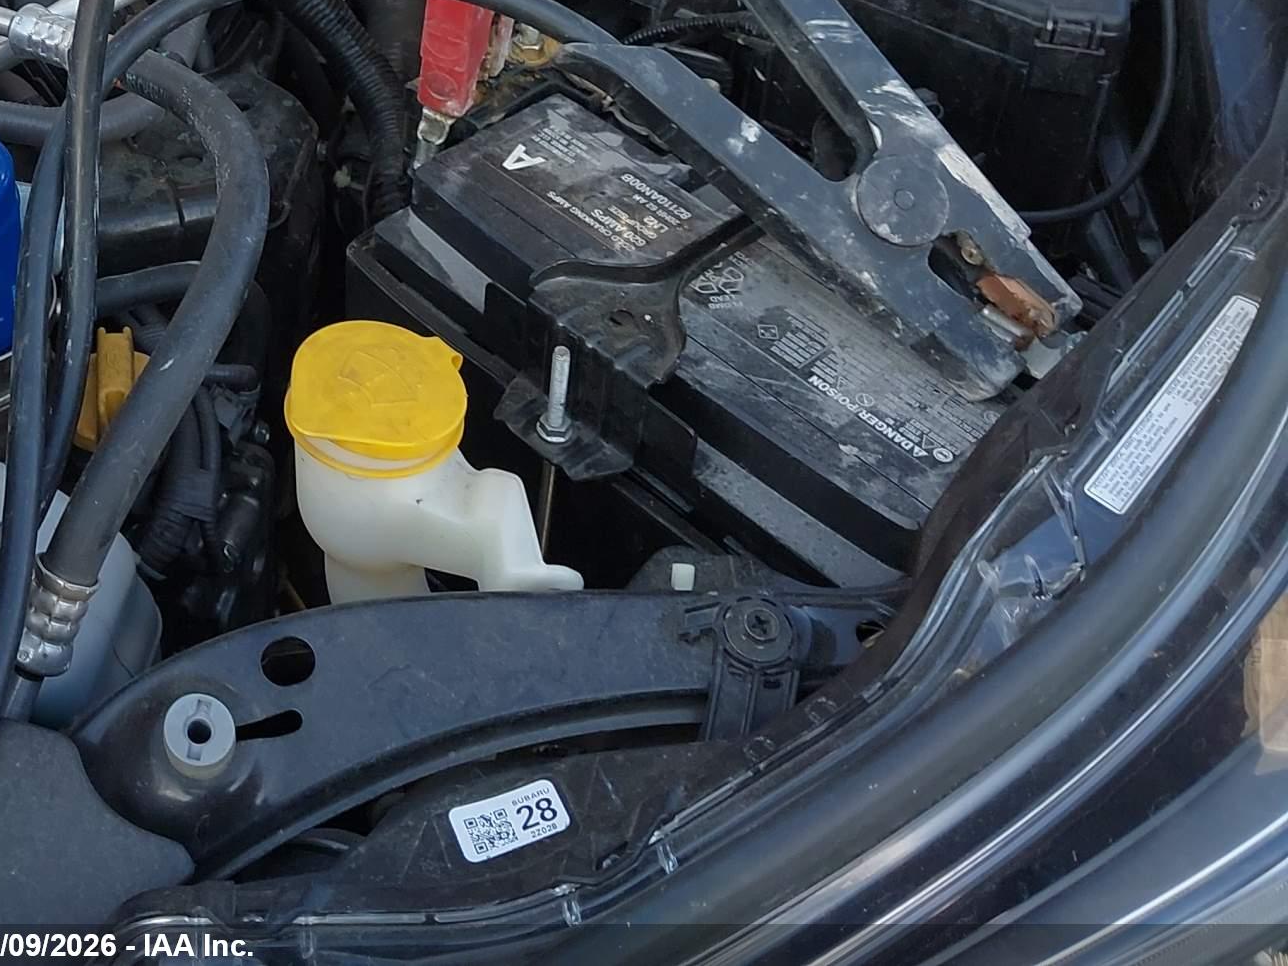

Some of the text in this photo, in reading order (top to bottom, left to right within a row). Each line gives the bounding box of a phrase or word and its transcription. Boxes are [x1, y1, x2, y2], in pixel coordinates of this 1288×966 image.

[546, 190, 571, 207] AMPS
[590, 207, 646, 246] 620 AMPS
[511, 787, 551, 807] SUBARU
[516, 797, 558, 831] 28
